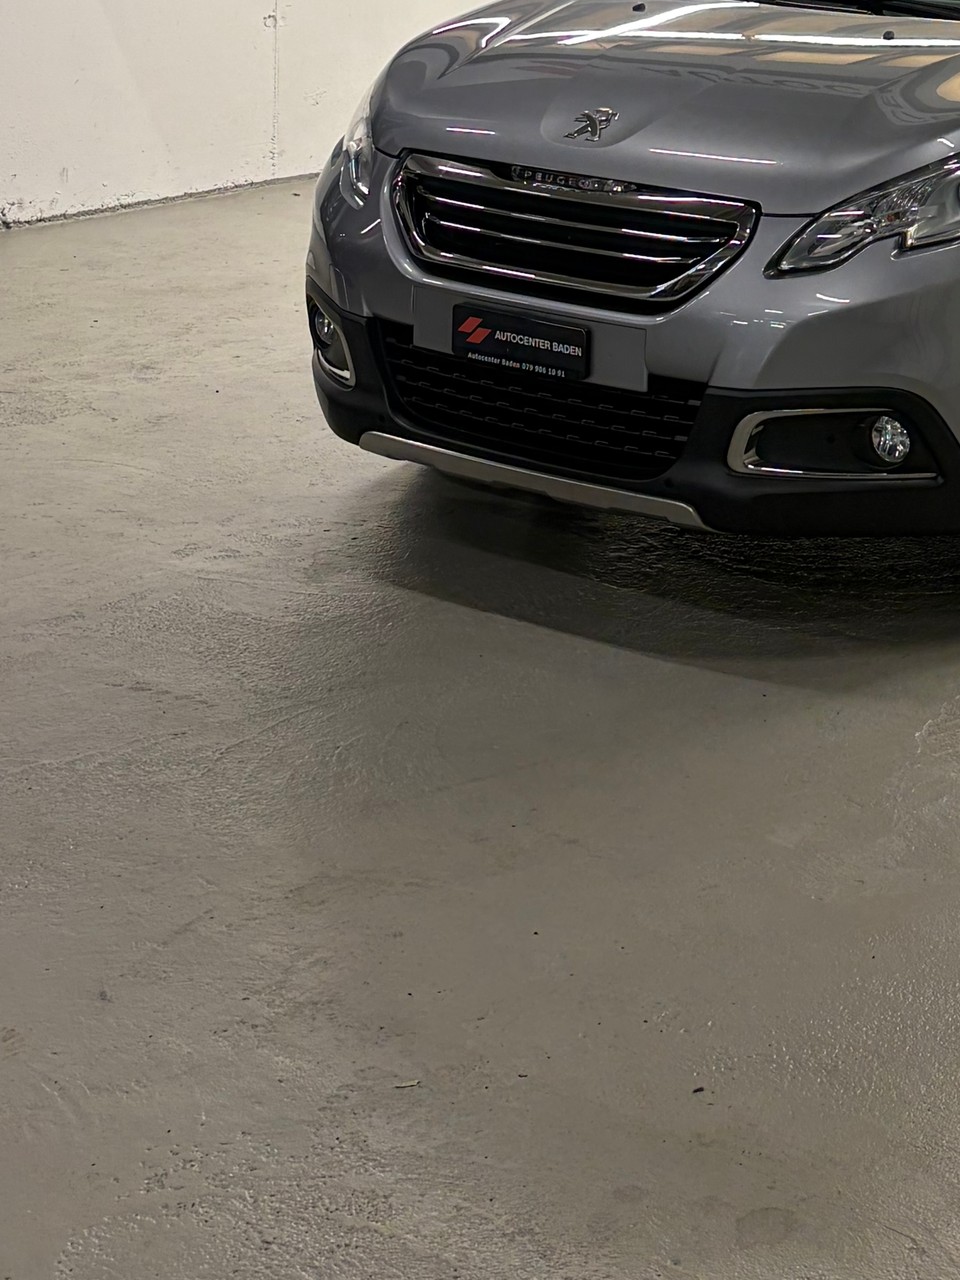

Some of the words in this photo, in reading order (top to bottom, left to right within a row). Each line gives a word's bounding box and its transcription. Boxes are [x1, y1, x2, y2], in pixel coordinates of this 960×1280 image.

[494, 330, 551, 350] AUTOCENTER
[552, 342, 582, 357] BADEN
[467, 352, 500, 365] Autocenter
[501, 360, 520, 369] Baden
[521, 363, 534, 371] 079
[548, 368, 556, 376] 10
